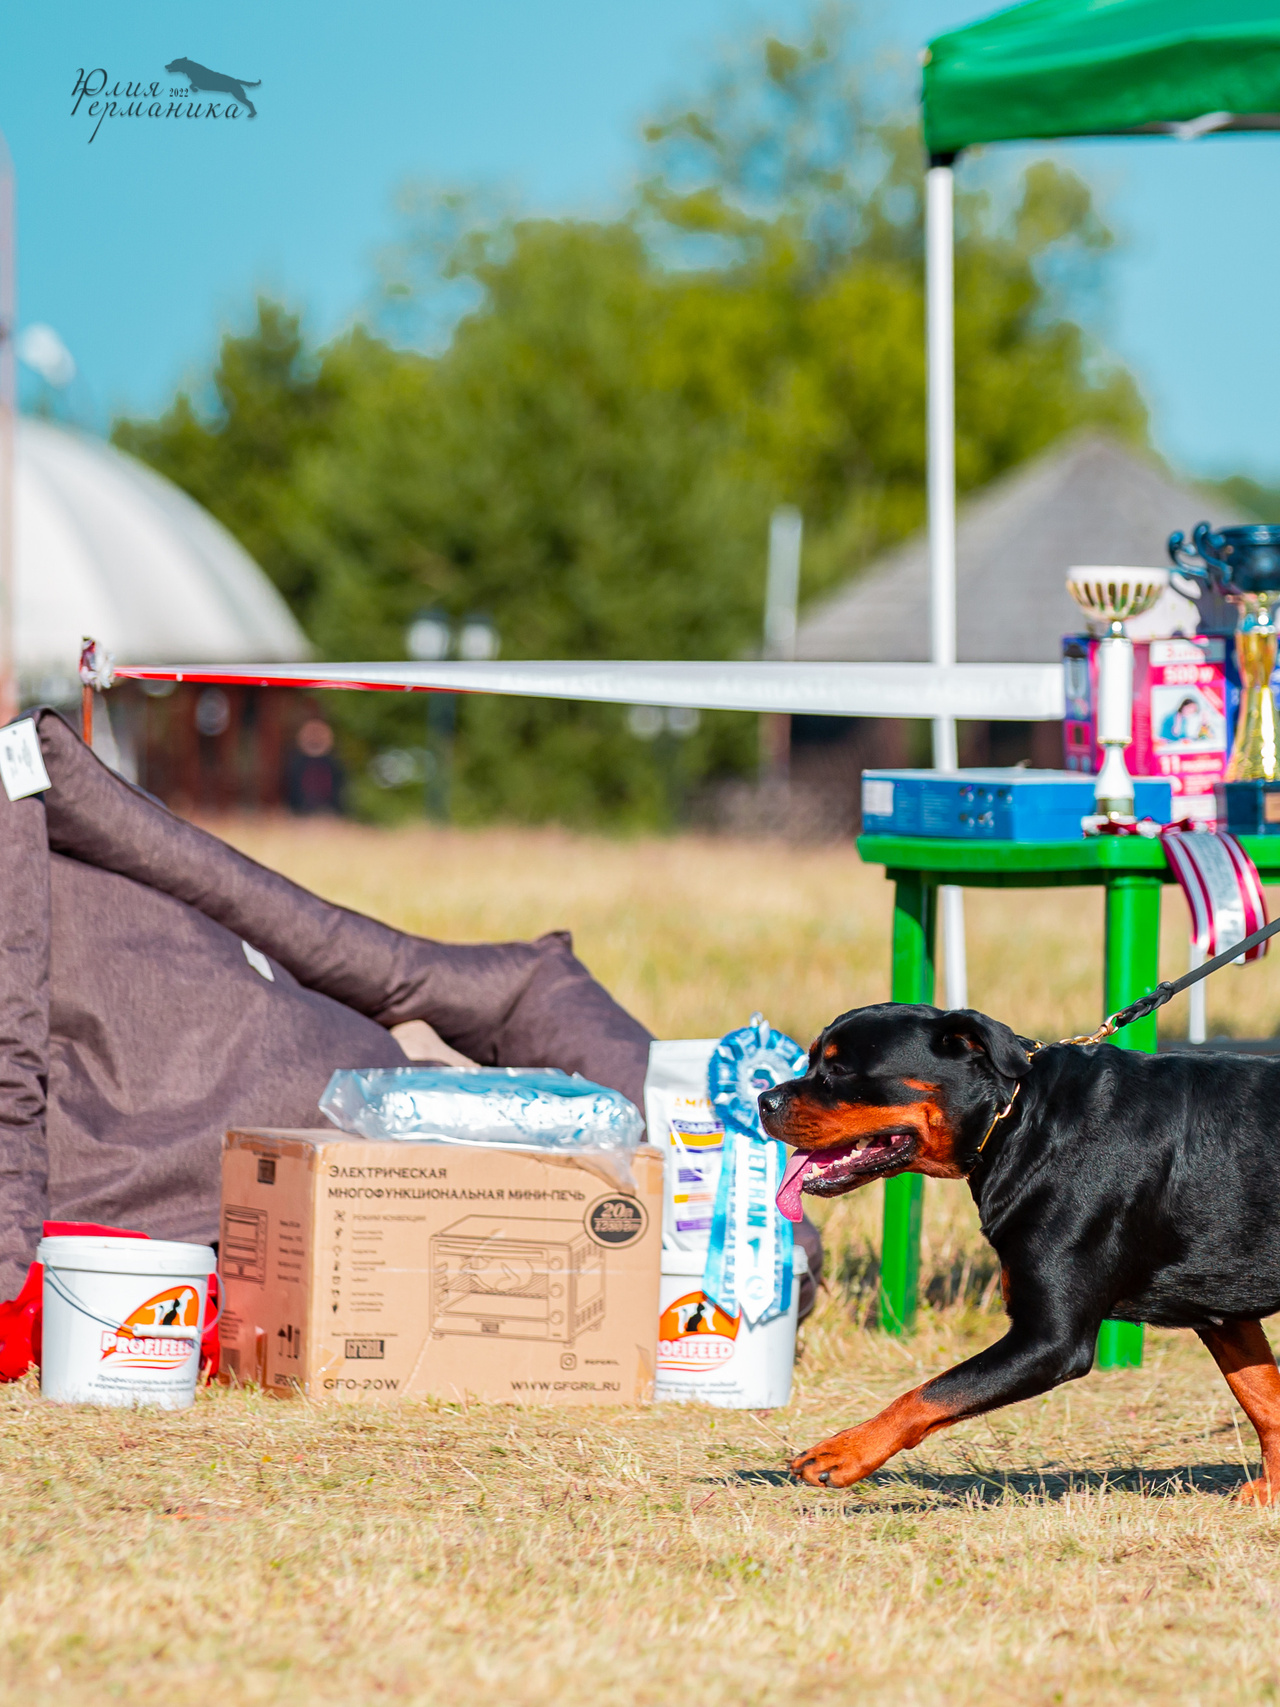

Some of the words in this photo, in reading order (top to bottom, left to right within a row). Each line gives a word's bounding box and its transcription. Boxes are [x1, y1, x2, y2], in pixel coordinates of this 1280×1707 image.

[328, 1187, 504, 1200] МНОГОФУНКЦИОНАЛЬНАЯ
[508, 1189, 586, 1201] МИНИ-ПЕЧЬ
[323, 1379, 400, 1391] GFO-20W
[511, 1381, 621, 1392] WWW.GFGRIL.RU
